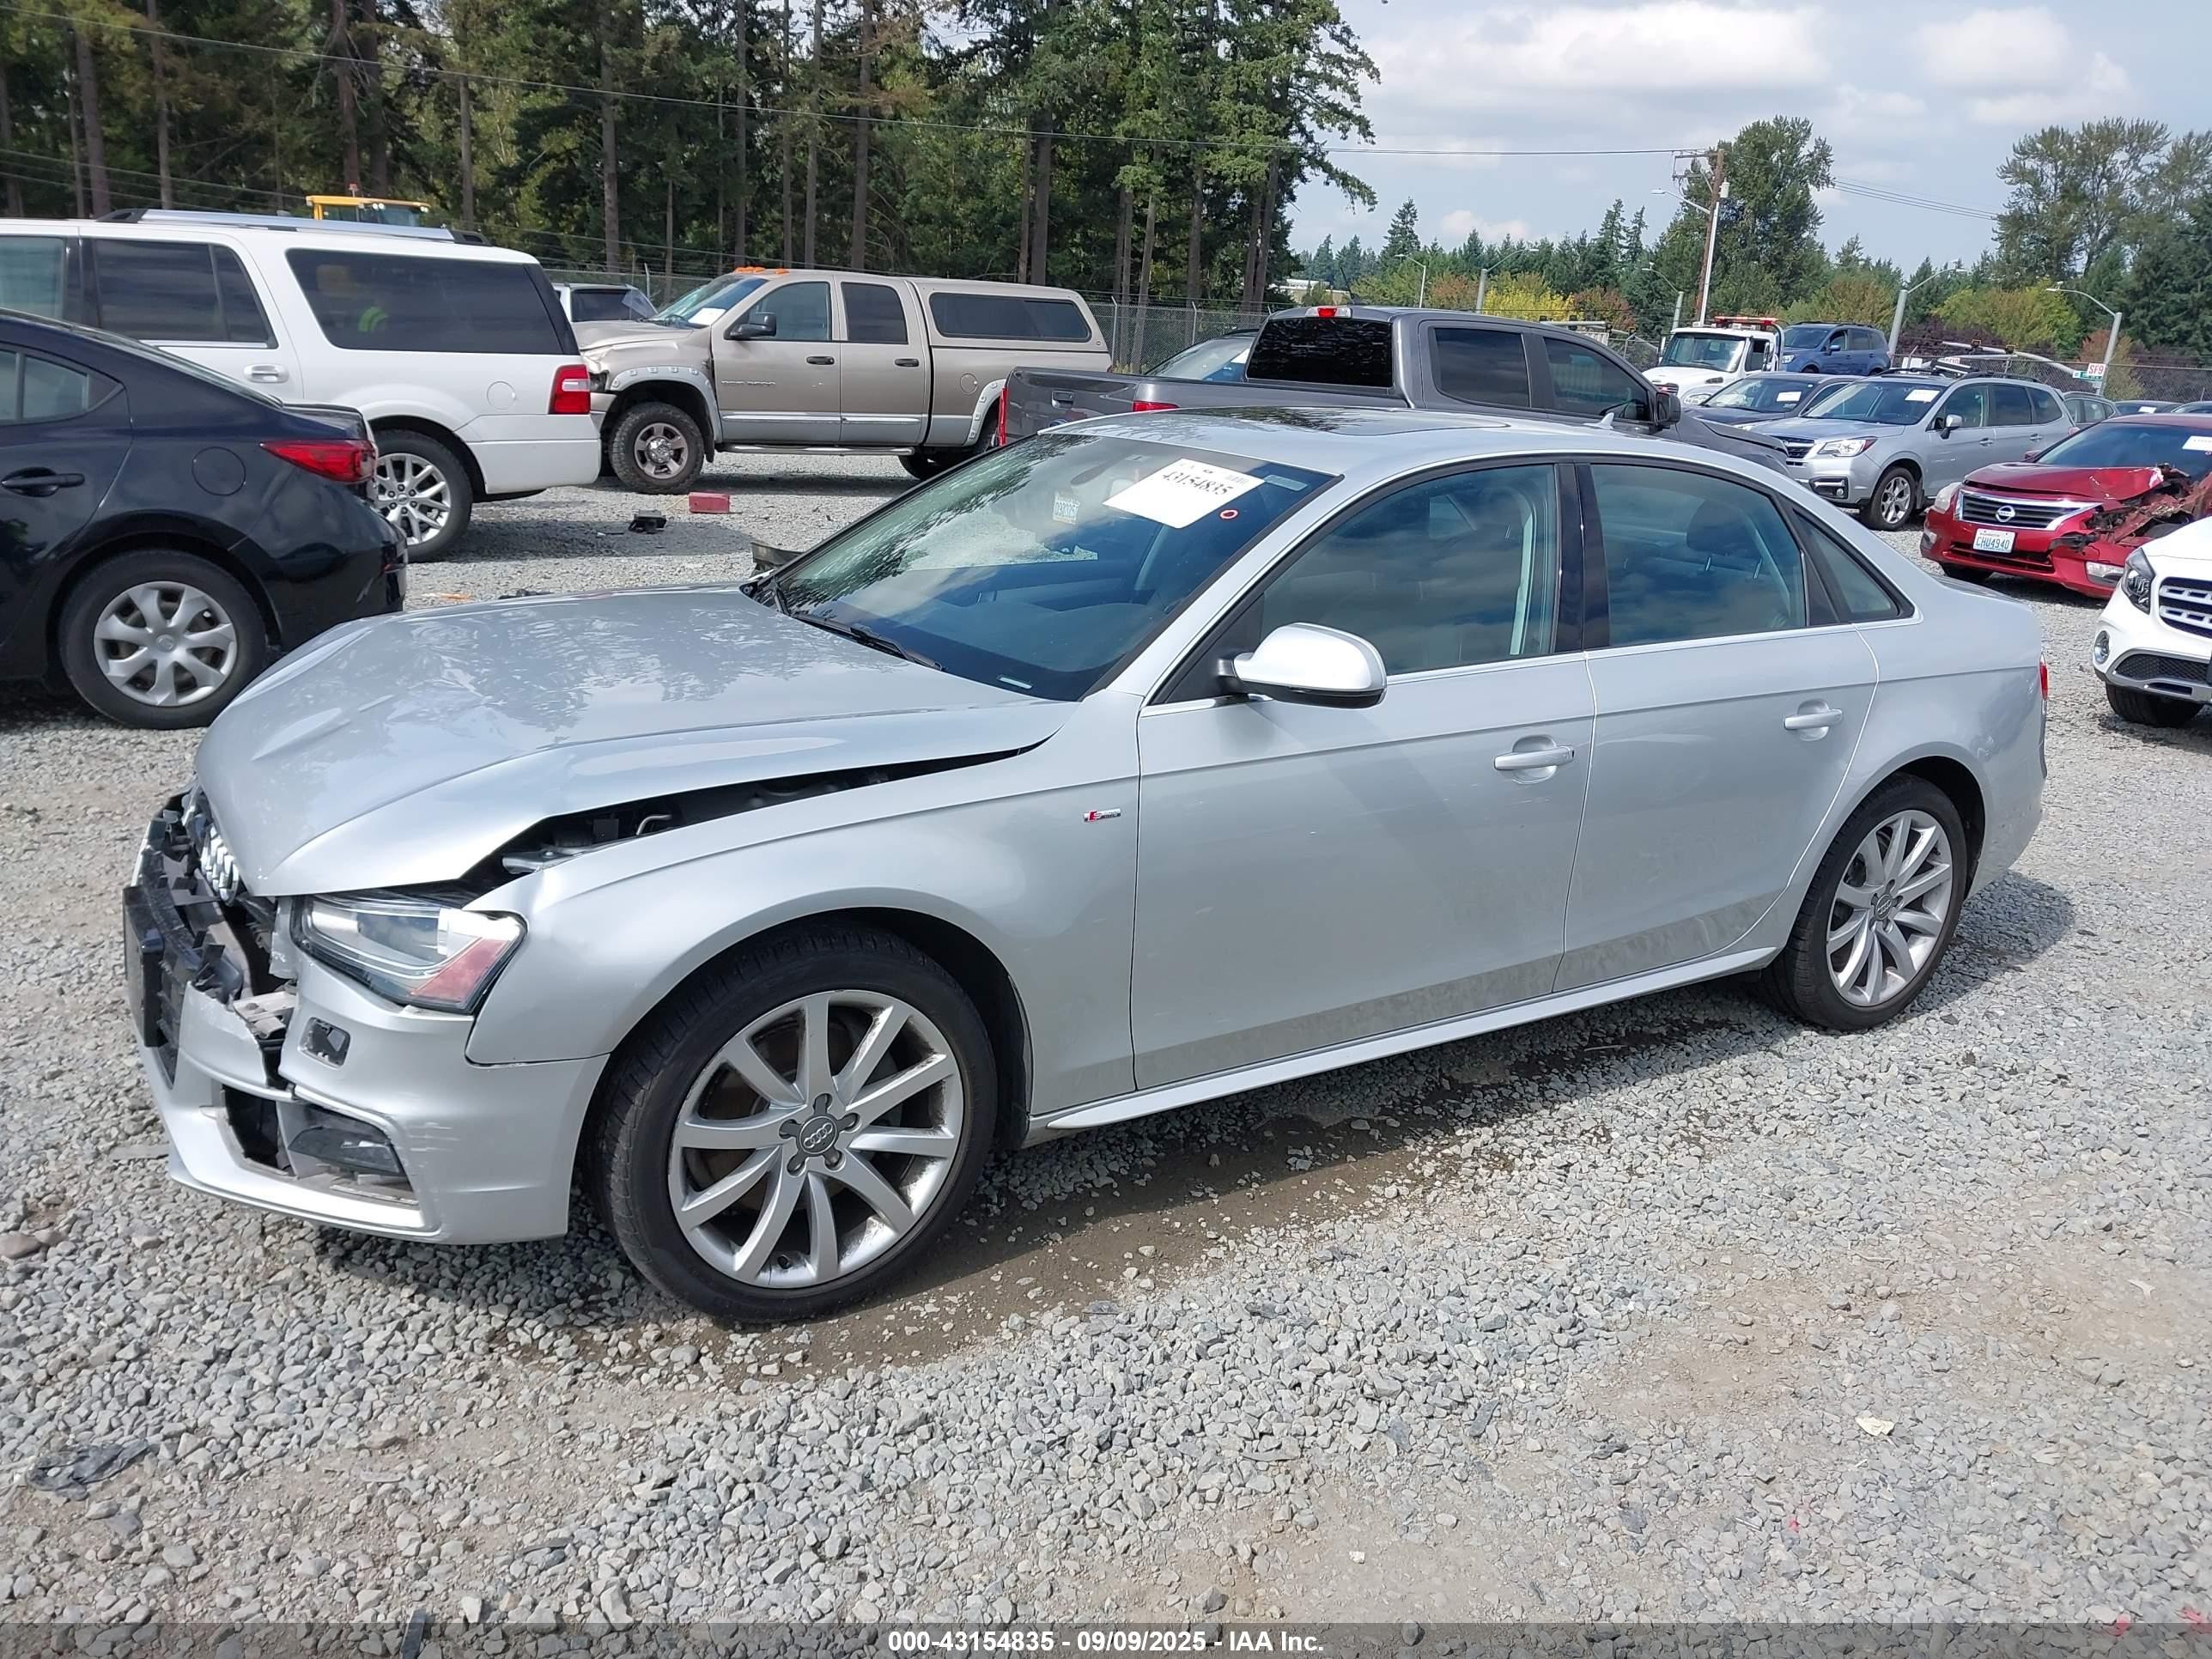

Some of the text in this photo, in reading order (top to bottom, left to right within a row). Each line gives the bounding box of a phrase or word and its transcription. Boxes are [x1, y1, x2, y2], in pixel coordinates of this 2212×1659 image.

[2088, 364, 2104, 374] SF9
[1162, 471, 1234, 495] 43154835
[1976, 536, 2010, 550] CHU4940
